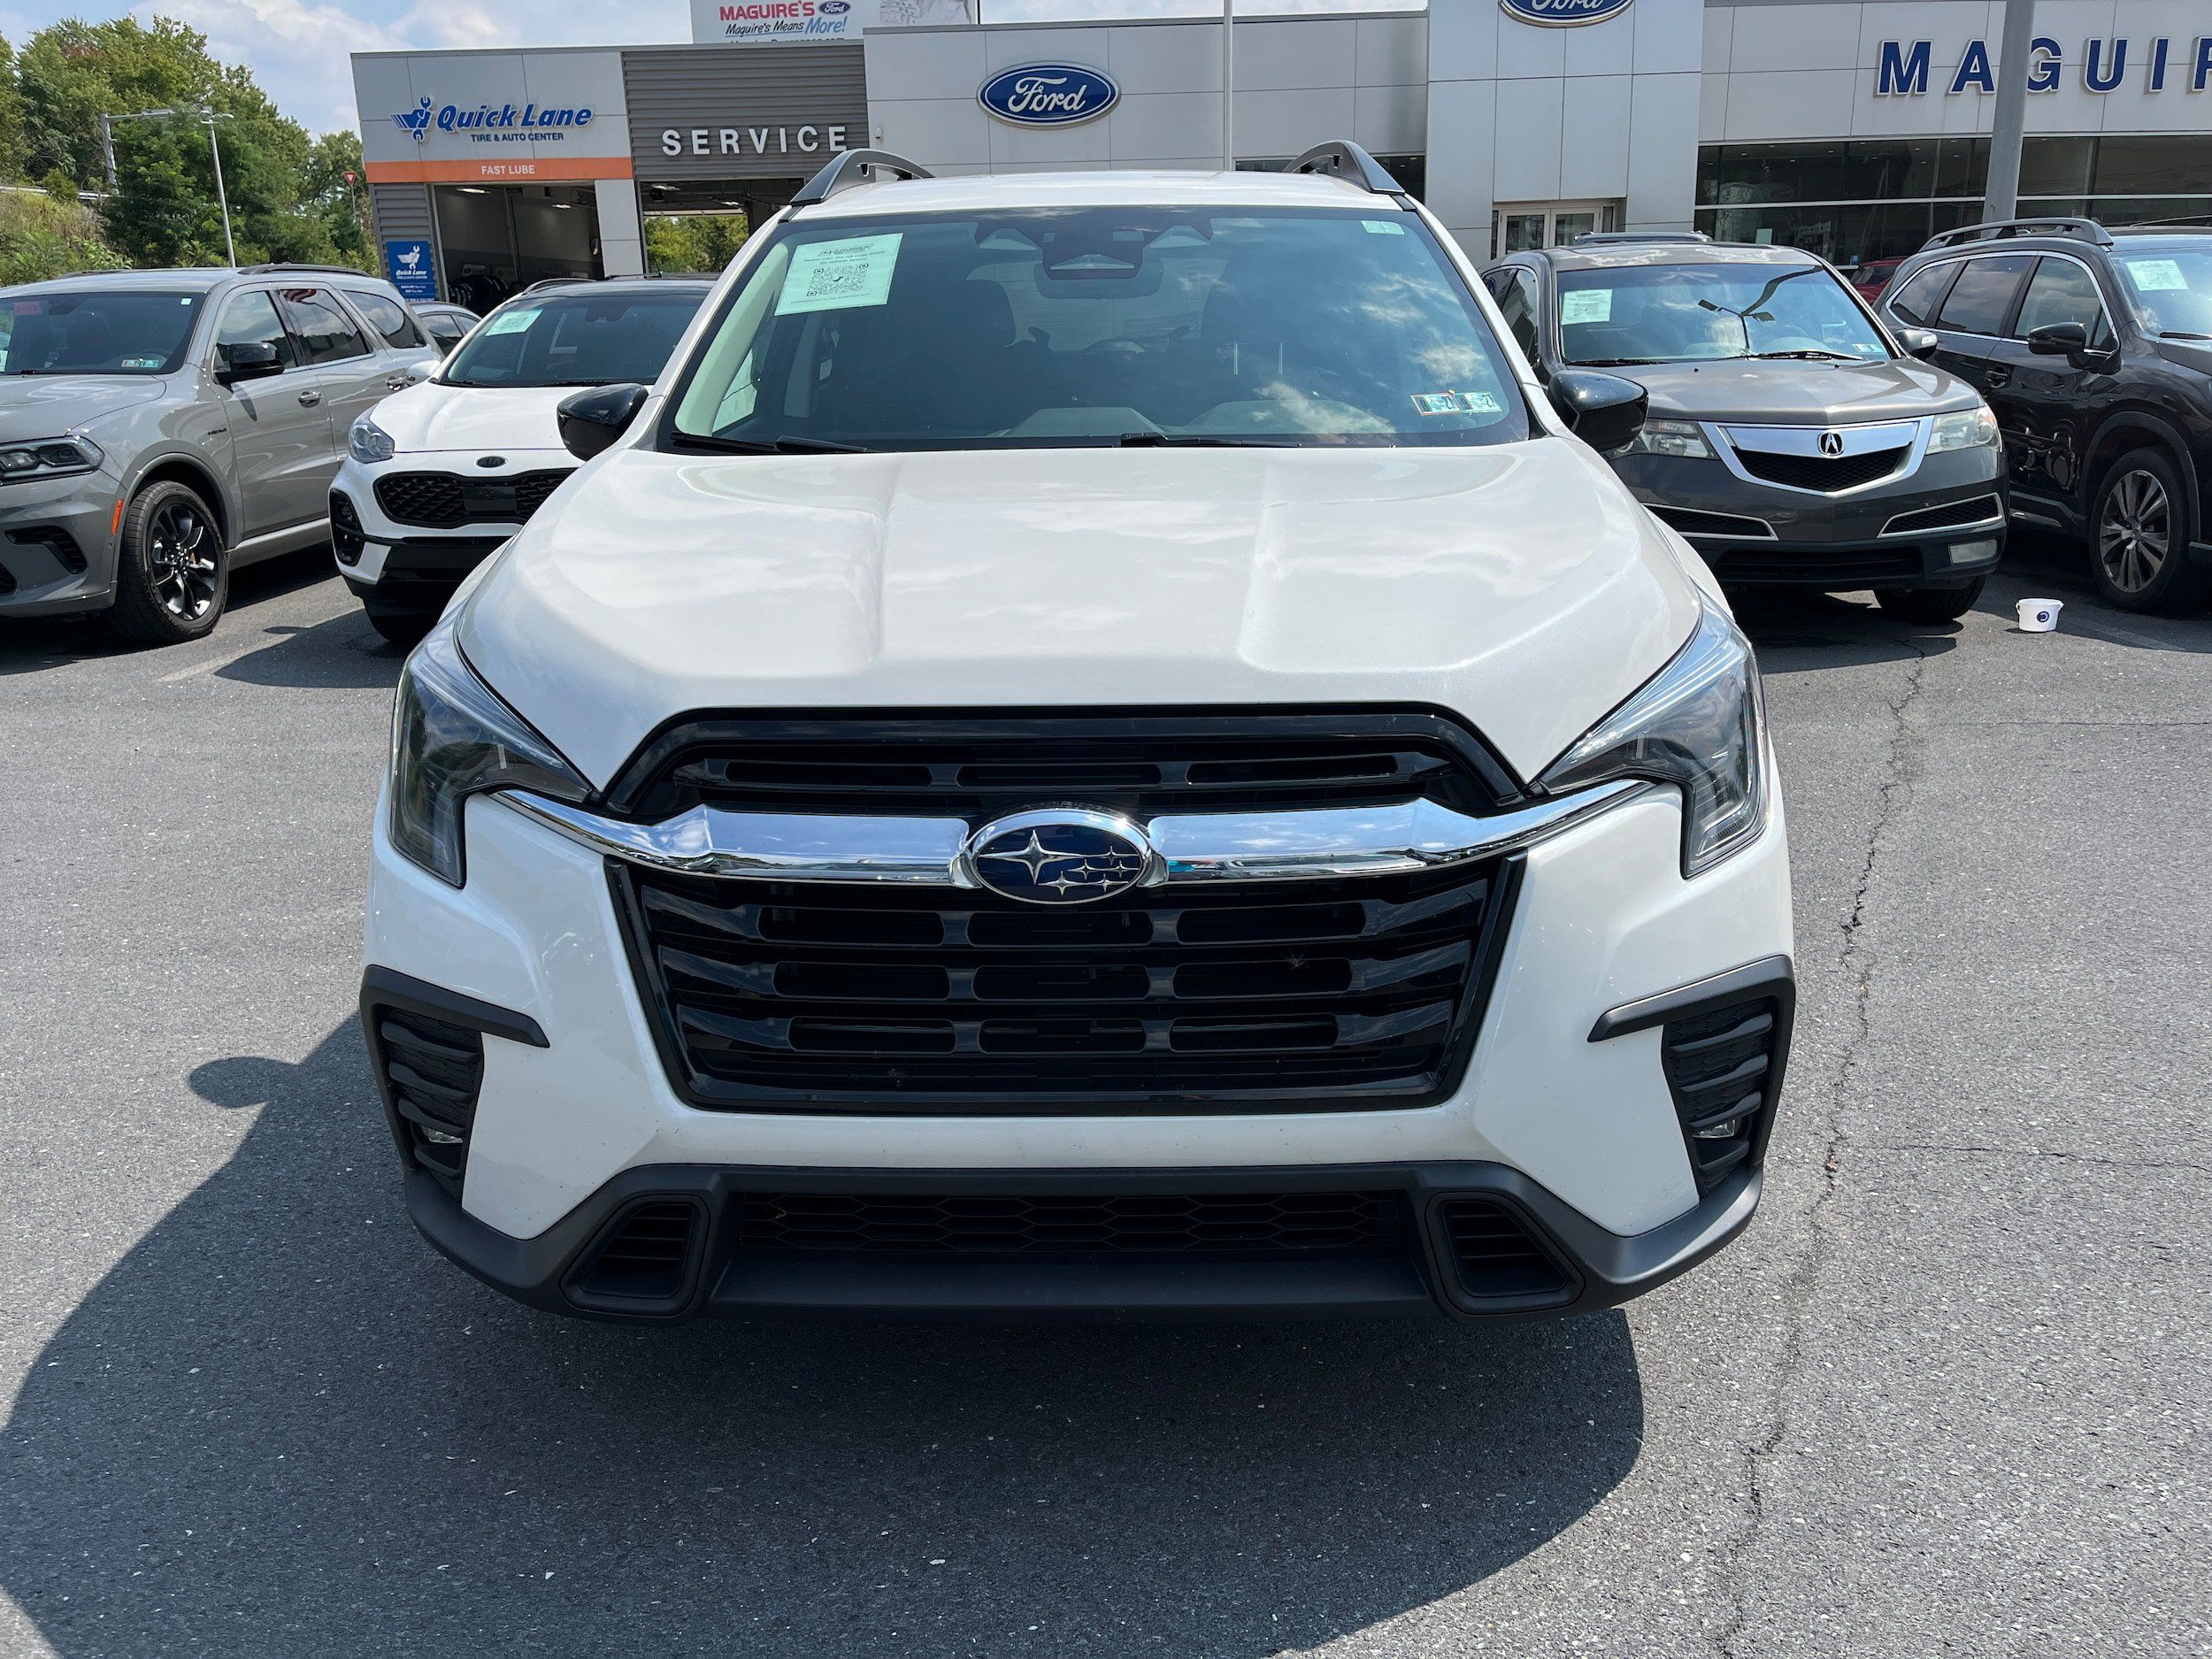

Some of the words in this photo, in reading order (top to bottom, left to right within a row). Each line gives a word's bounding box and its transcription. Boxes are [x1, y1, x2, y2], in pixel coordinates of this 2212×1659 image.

[719, 1, 815, 20] MAGUIRE'S
[726, 22, 771, 37] Maguire's
[773, 20, 804, 32] Means
[805, 16, 848, 35] More!
[1008, 77, 1087, 112] Ford
[437, 104, 518, 132] Quick
[520, 104, 592, 127] Lane
[471, 134, 493, 142] TIRE
[527, 133, 564, 142] CENTER
[662, 126, 847, 157] SERVICE
[481, 165, 506, 175] FAST
[509, 165, 535, 174] LUBE
